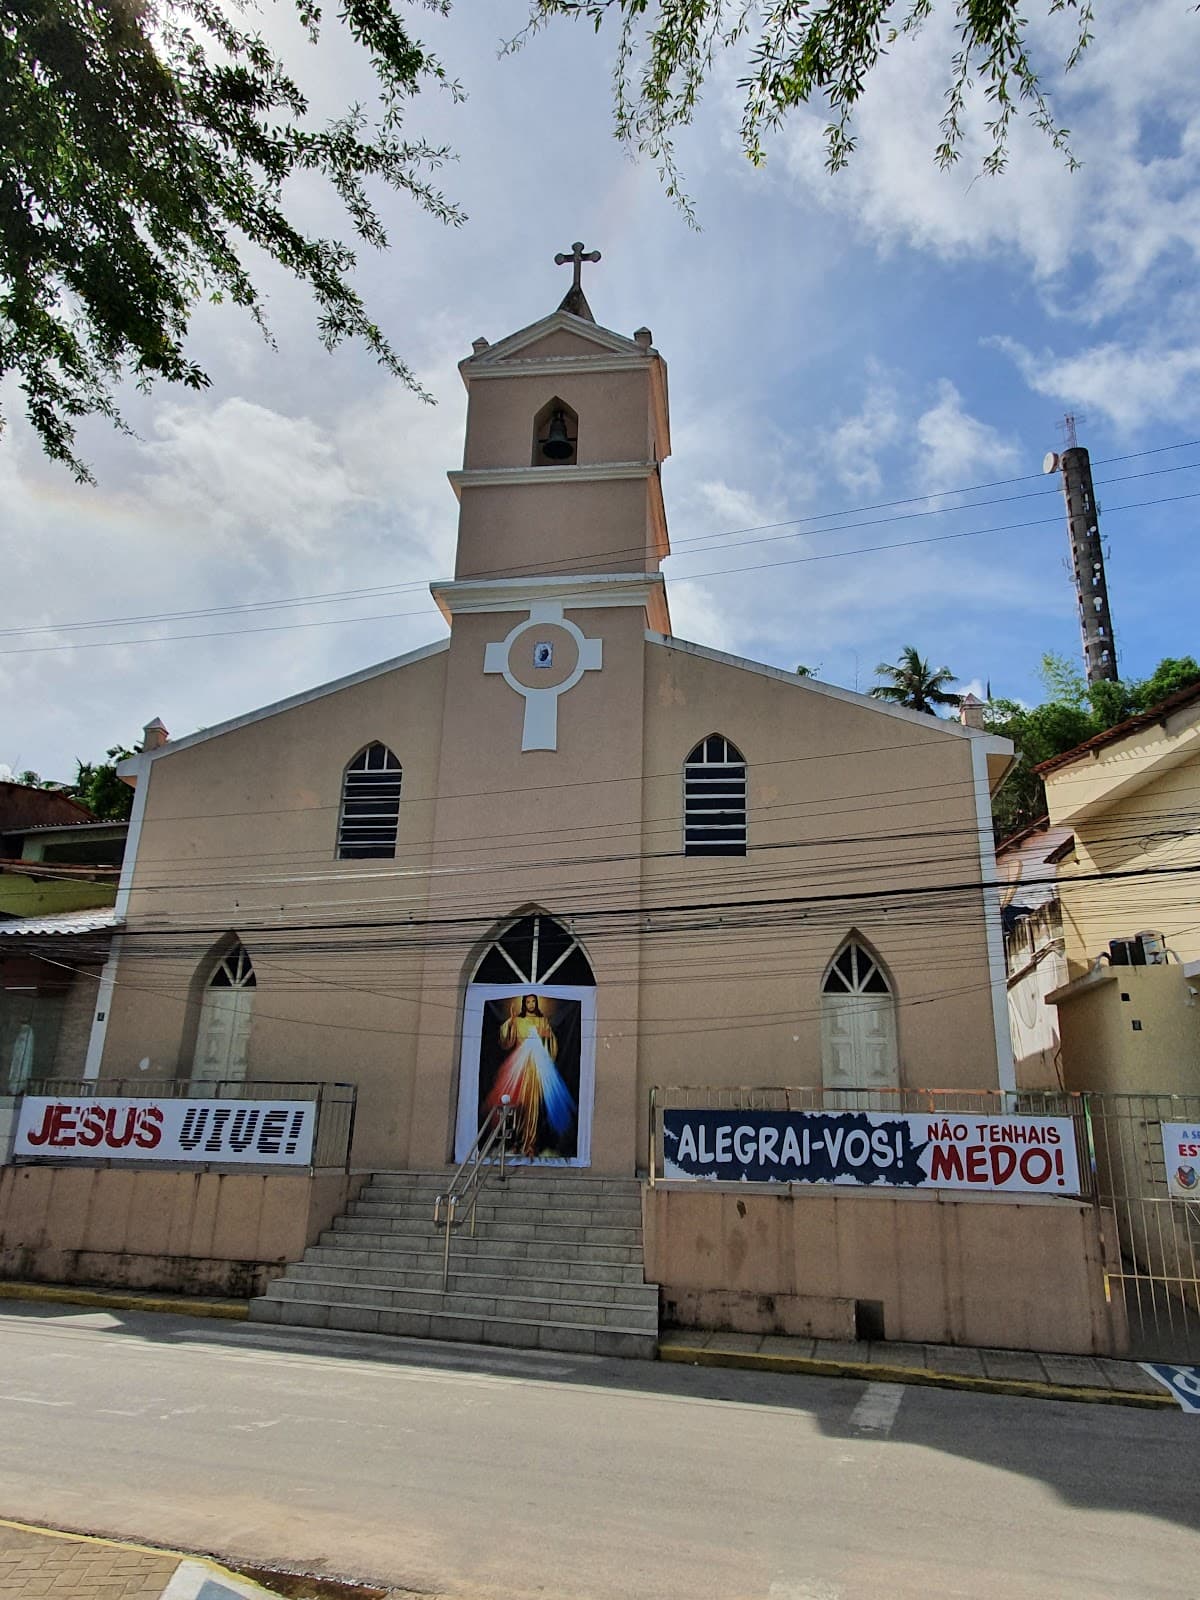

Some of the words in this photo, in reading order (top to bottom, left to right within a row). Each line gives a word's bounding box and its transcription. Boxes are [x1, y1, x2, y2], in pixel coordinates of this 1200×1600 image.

[27, 1103, 164, 1148] JESUS
[178, 1108, 305, 1155] VIVE!
[677, 1124, 904, 1169] ALEGRAI-VOS!
[927, 1119, 968, 1141] NÃO
[976, 1124, 1061, 1144] TENHAIS
[930, 1144, 1065, 1186] MEDO!
